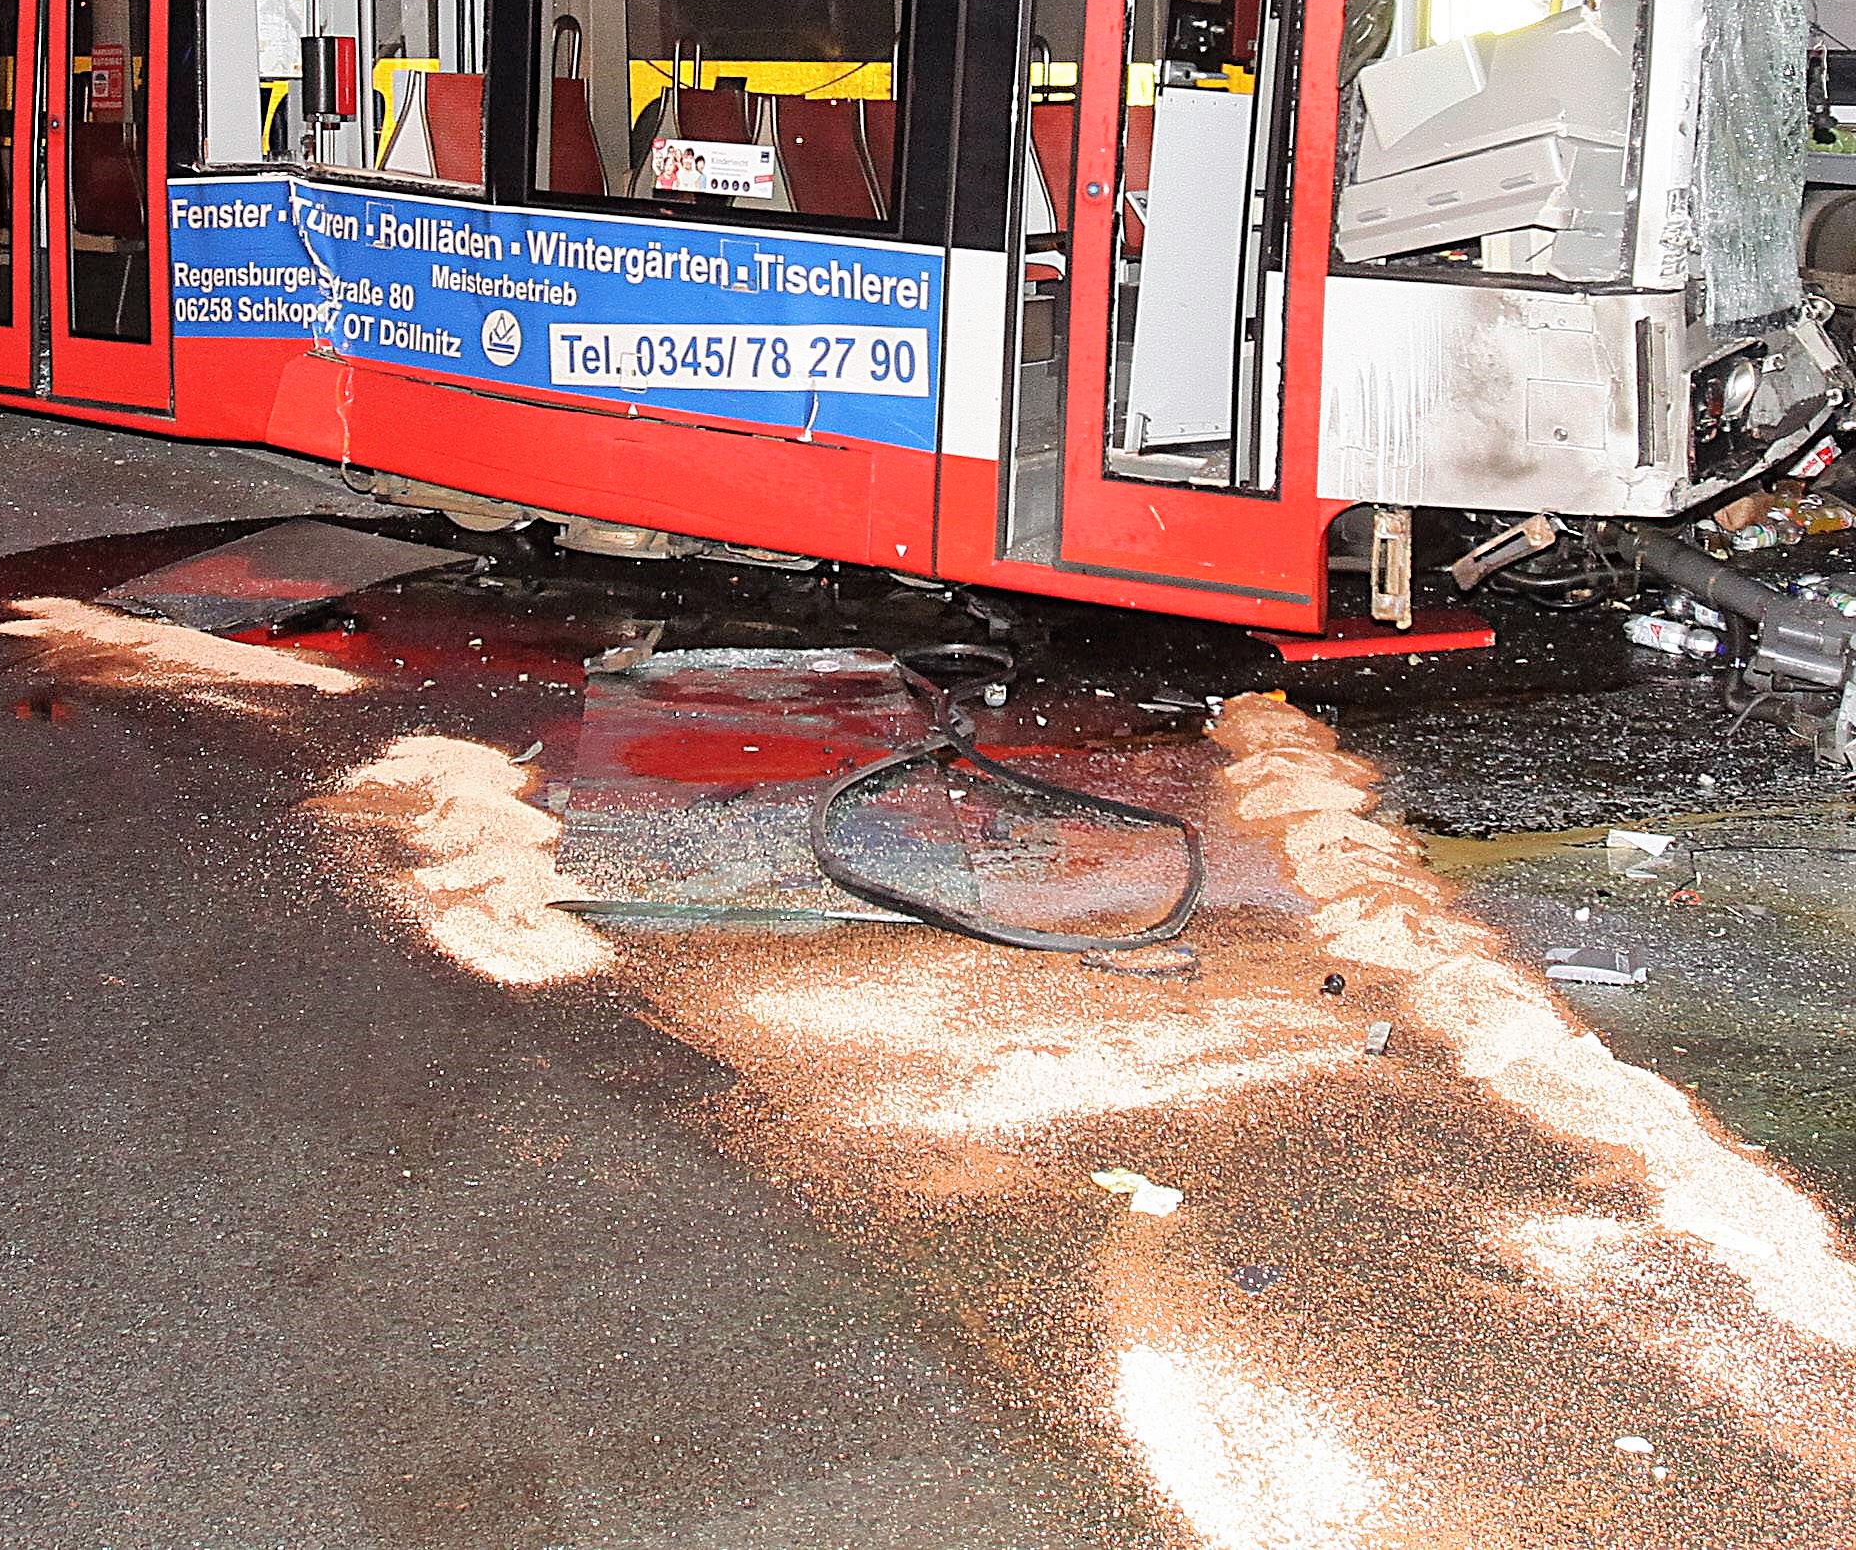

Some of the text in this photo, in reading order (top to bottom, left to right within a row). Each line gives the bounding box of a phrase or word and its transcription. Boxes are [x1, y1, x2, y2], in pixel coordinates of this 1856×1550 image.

[171, 196, 930, 311] Fenster Türen Rollläden Wintergärten Tischlerei
[389, 282, 415, 311] 80
[432, 263, 577, 307] Meisterbetrieb
[175, 297, 233, 322] 06258
[344, 313, 375, 342] OT
[379, 319, 462, 358] Döllnitz
[746, 336, 792, 380] 78
[808, 336, 857, 380] 27
[869, 338, 916, 384] 90
